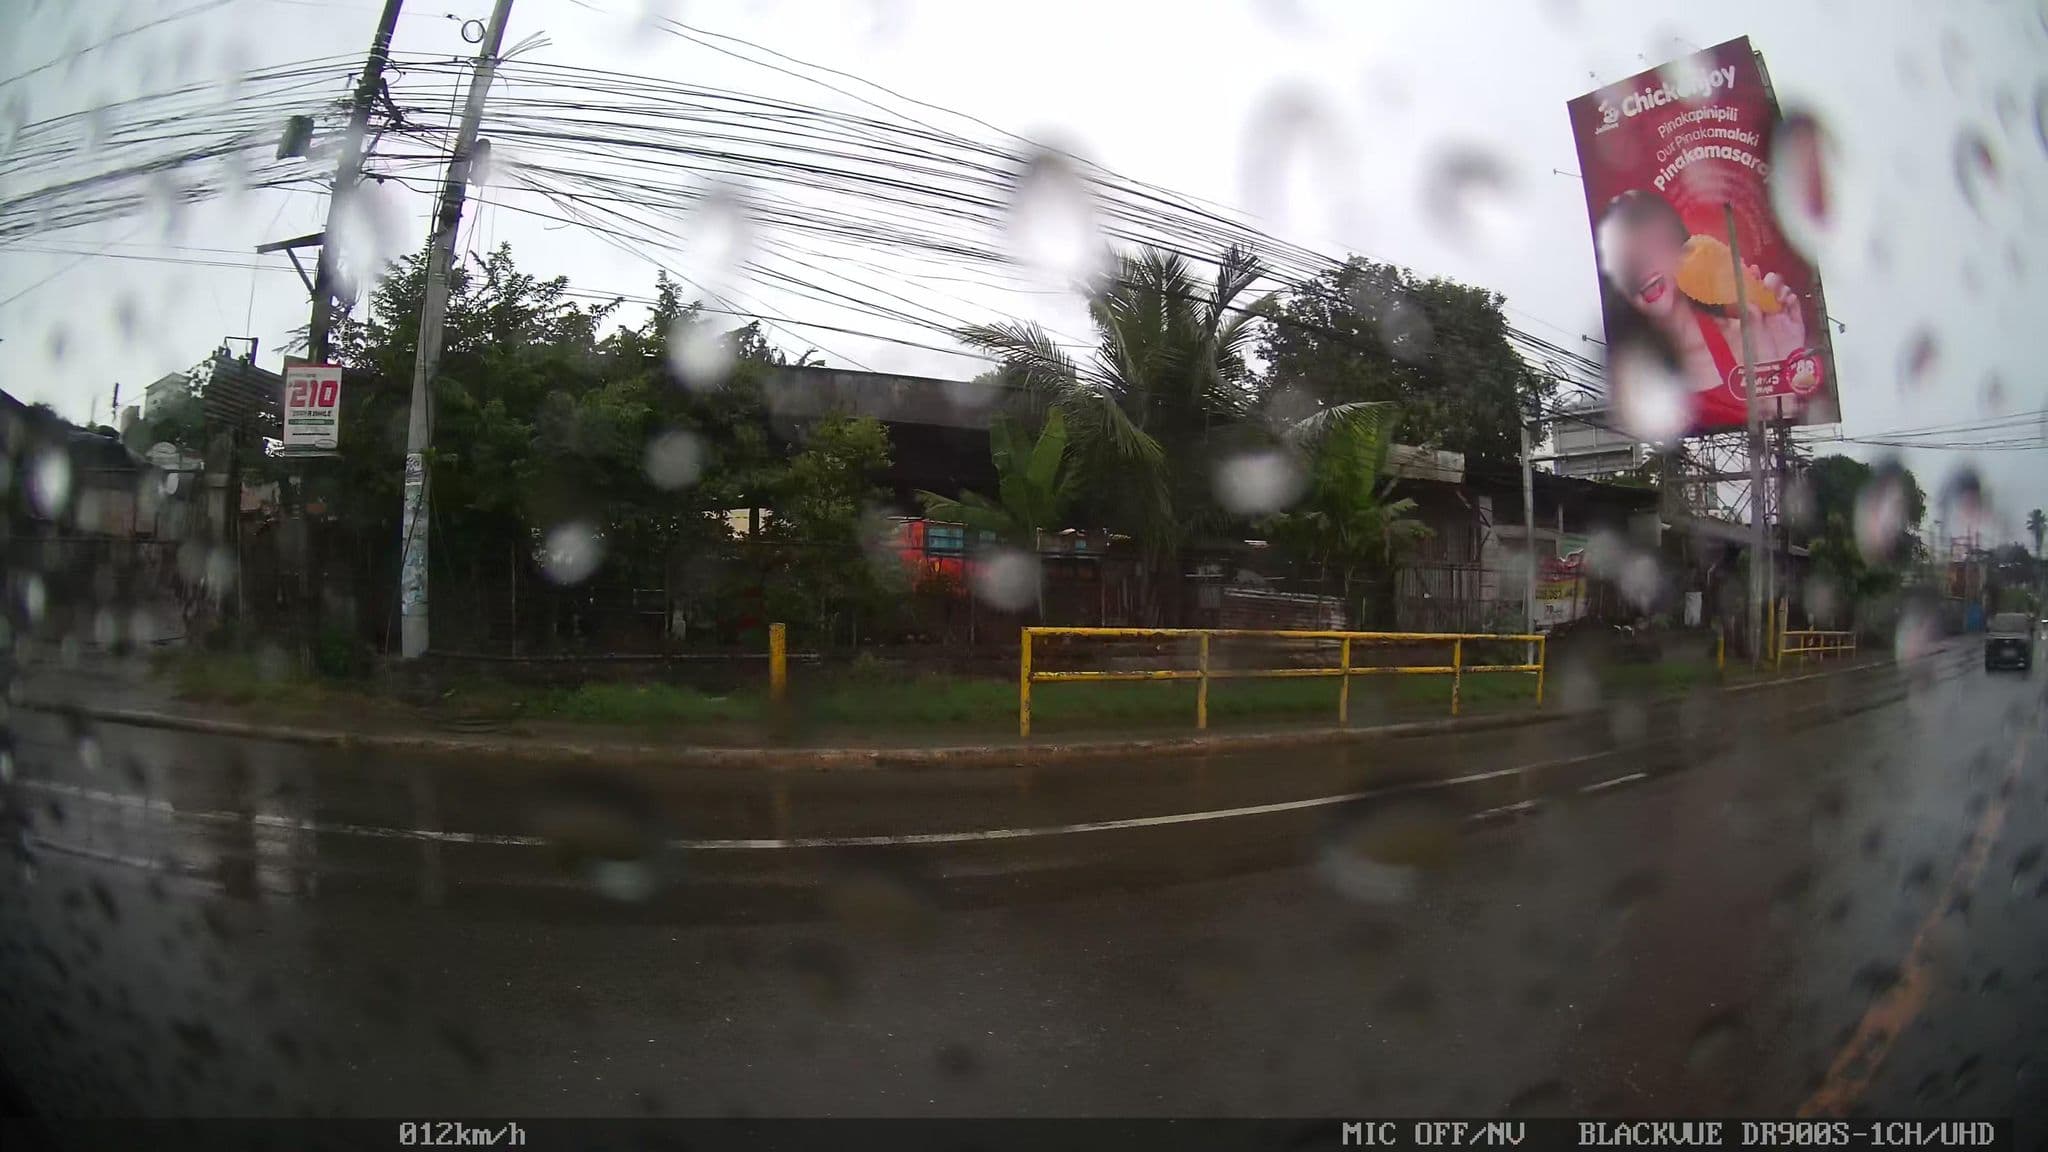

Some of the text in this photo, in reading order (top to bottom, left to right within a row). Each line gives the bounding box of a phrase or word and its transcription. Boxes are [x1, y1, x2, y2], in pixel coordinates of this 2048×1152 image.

[1621, 65, 1736, 117] Chickjoy
[1657, 105, 1738, 138] Pinakapinipili
[1656, 127, 1760, 163] Our Pinakamalaki
[289, 380, 338, 407] 210
